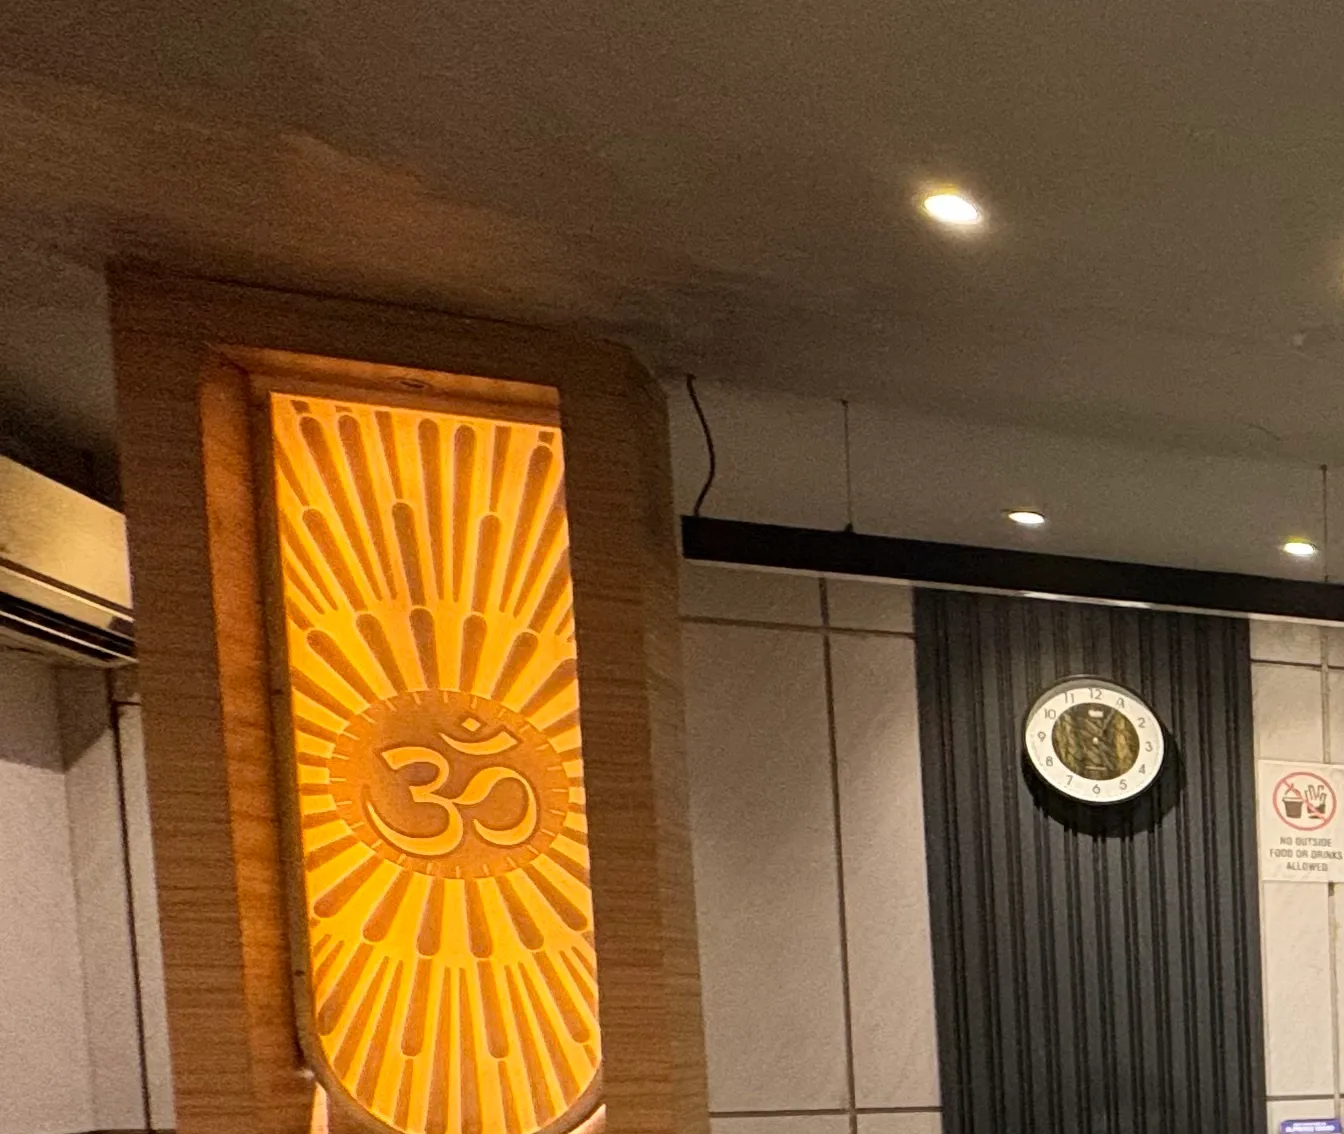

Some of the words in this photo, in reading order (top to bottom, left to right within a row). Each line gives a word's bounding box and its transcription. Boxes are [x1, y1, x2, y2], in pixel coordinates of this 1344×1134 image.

[1064, 691, 1075, 704] 11
[1089, 688, 1102, 700] 12
[1044, 708, 1057, 720] 10
[1137, 717, 1146, 729] 2
[1037, 731, 1046, 742] 9
[1144, 741, 1153, 753] 3
[1045, 755, 1054, 768] 8
[1138, 764, 1146, 776] 4
[1066, 775, 1073, 786] 7
[1118, 779, 1127, 791] 5
[1092, 784, 1101, 795] 6
[1280, 836, 1293, 846] NO
[1295, 837, 1332, 847] OUTSIDE
[1269, 848, 1293, 858] FOOD
[1295, 849, 1309, 859] OR
[1310, 850, 1343, 860] DRINKS
[1286, 862, 1328, 871] ALLOWED
